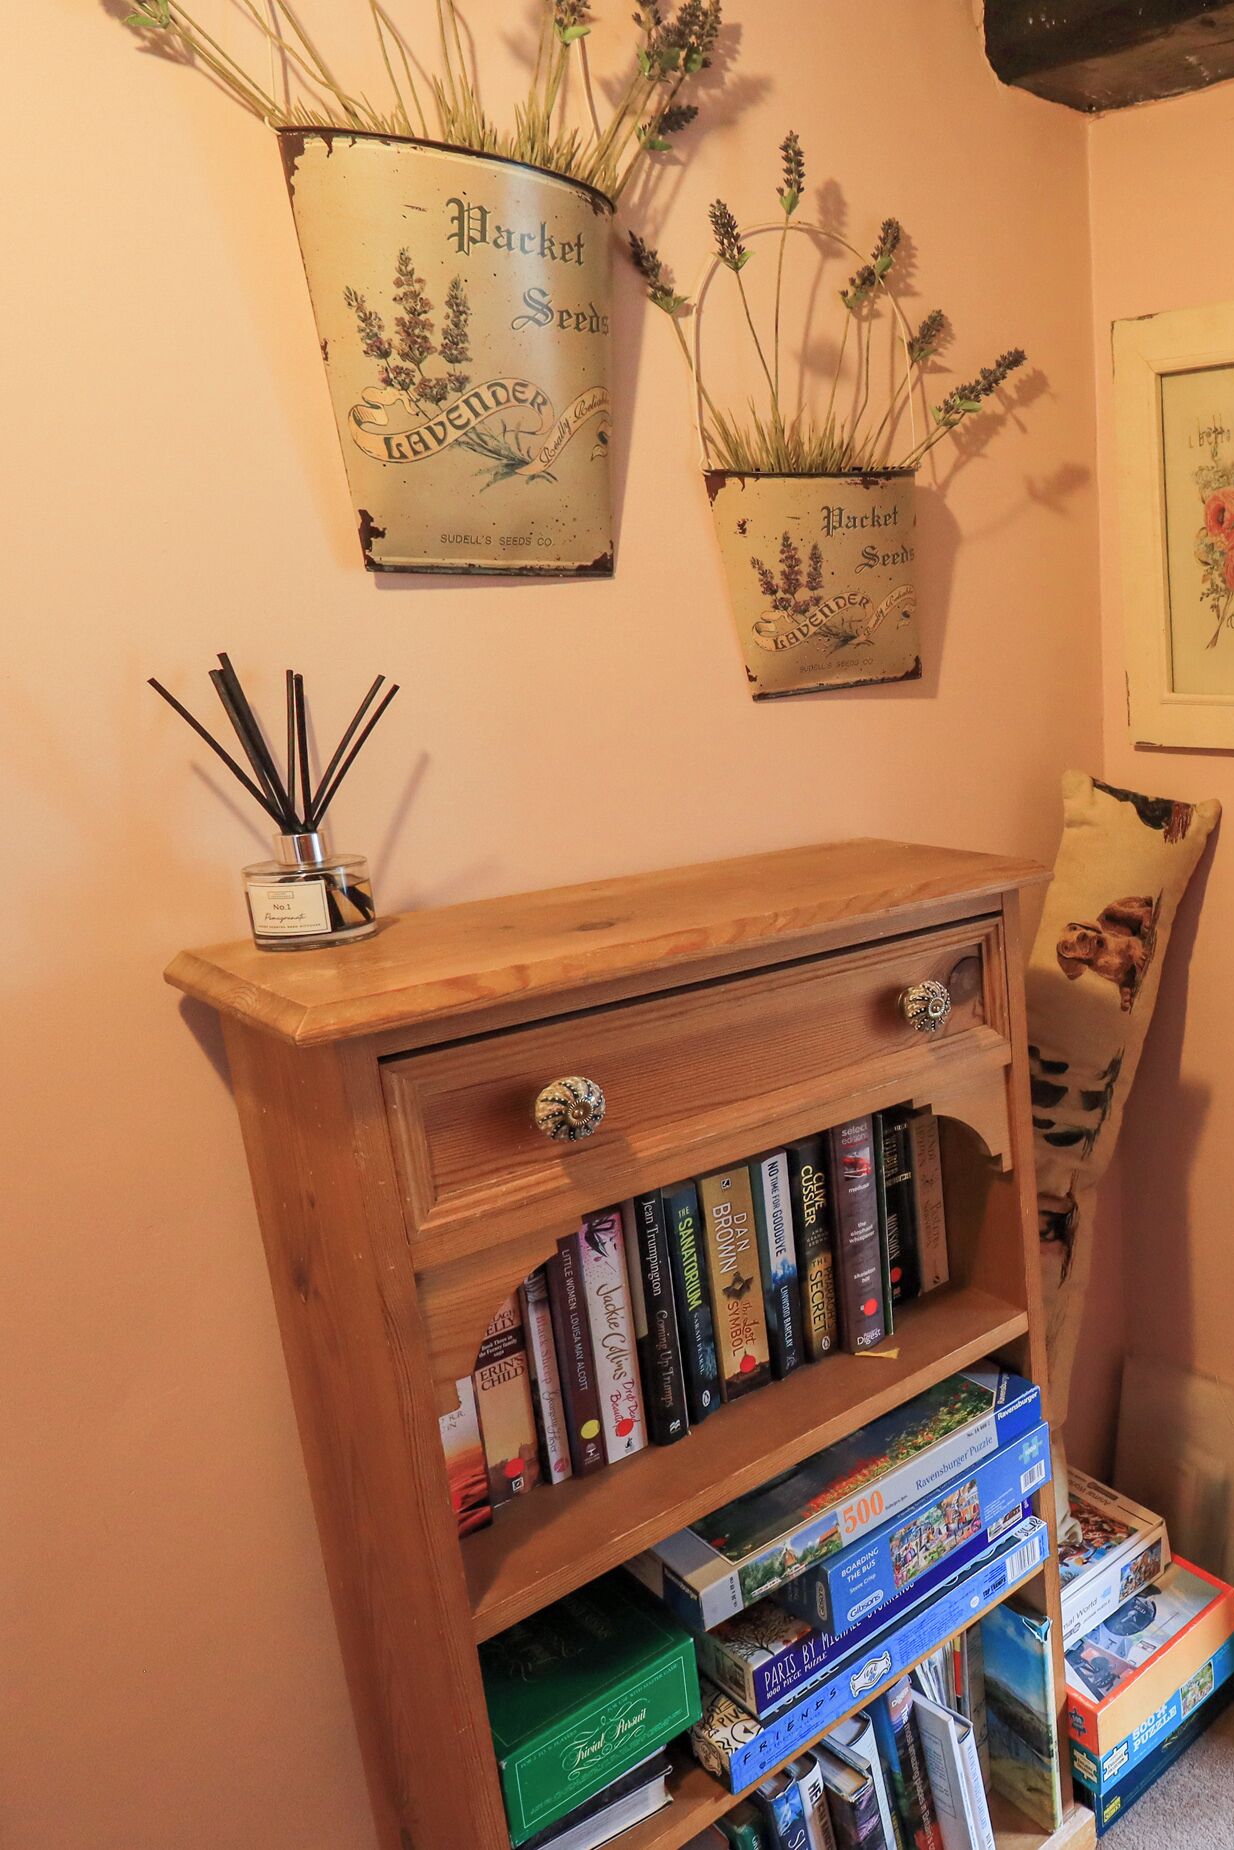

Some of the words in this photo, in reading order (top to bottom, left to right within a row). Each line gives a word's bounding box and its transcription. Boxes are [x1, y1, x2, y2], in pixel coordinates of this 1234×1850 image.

[446, 198, 584, 266] Packet
[511, 288, 608, 336] Seeds
[384, 381, 548, 460] LAVENDER
[821, 505, 898, 537] Packet
[440, 533, 492, 544] SUDELL'S
[500, 537, 532, 546] SEEDS
[773, 593, 870, 650] LAVENDER
[273, 903, 291, 911] No.1
[842, 1123, 868, 1137] select
[768, 1162, 779, 1177] NO
[770, 1179, 779, 1195] TIME
[773, 1195, 781, 1208] FOR
[801, 1165, 816, 1227] CUSSLER
[813, 1172, 826, 1211] CLIVE
[642, 1199, 655, 1225] Jean
[678, 1206, 690, 1218] THE
[713, 1202, 738, 1274] BROWN
[734, 1212, 751, 1252] DAN
[773, 1209, 786, 1257] GOODBYE
[560, 1249, 573, 1277] LITTLE
[646, 1224, 662, 1296] Trumpington
[678, 1218, 702, 1311] SANATORIUM
[811, 1257, 827, 1267] THE
[564, 1277, 577, 1309] WOMEN
[596, 1282, 623, 1331] Jackie
[809, 1271, 826, 1332] SECRET
[486, 1318, 515, 1337] ELLY
[568, 1312, 582, 1342] LOUISA
[728, 1301, 744, 1356] SYMBOL
[573, 1342, 584, 1359] MAY
[601, 1326, 628, 1381] Collins
[480, 1355, 524, 1381] ERIN'S
[481, 1365, 524, 1391] CHILD
[575, 1361, 588, 1391] ALCOTT
[998, 1392, 1038, 1420] Ravensburger
[843, 1490, 884, 1534] 500
[915, 1452, 969, 1491] Ravensburger
[969, 1437, 993, 1456] Puzzle
[841, 1547, 880, 1578] BOARDING
[848, 1569, 861, 1583] THE
[862, 1559, 876, 1574] BUS
[850, 1593, 881, 1618] Gibsons
[764, 1653, 796, 1691] PARIS
[802, 1637, 815, 1663] BY
[767, 1685, 781, 1699] 1000
[804, 1652, 828, 1672] PUZZLE
[743, 1688, 837, 1765] FRIENDS
[898, 1704, 912, 1723] The
[1132, 1704, 1177, 1752] PUZZLE
[562, 1732, 605, 1770] Trivial
[605, 1708, 647, 1742] Pursuit
[901, 1722, 915, 1744] most
[903, 1743, 922, 1778] amazing
